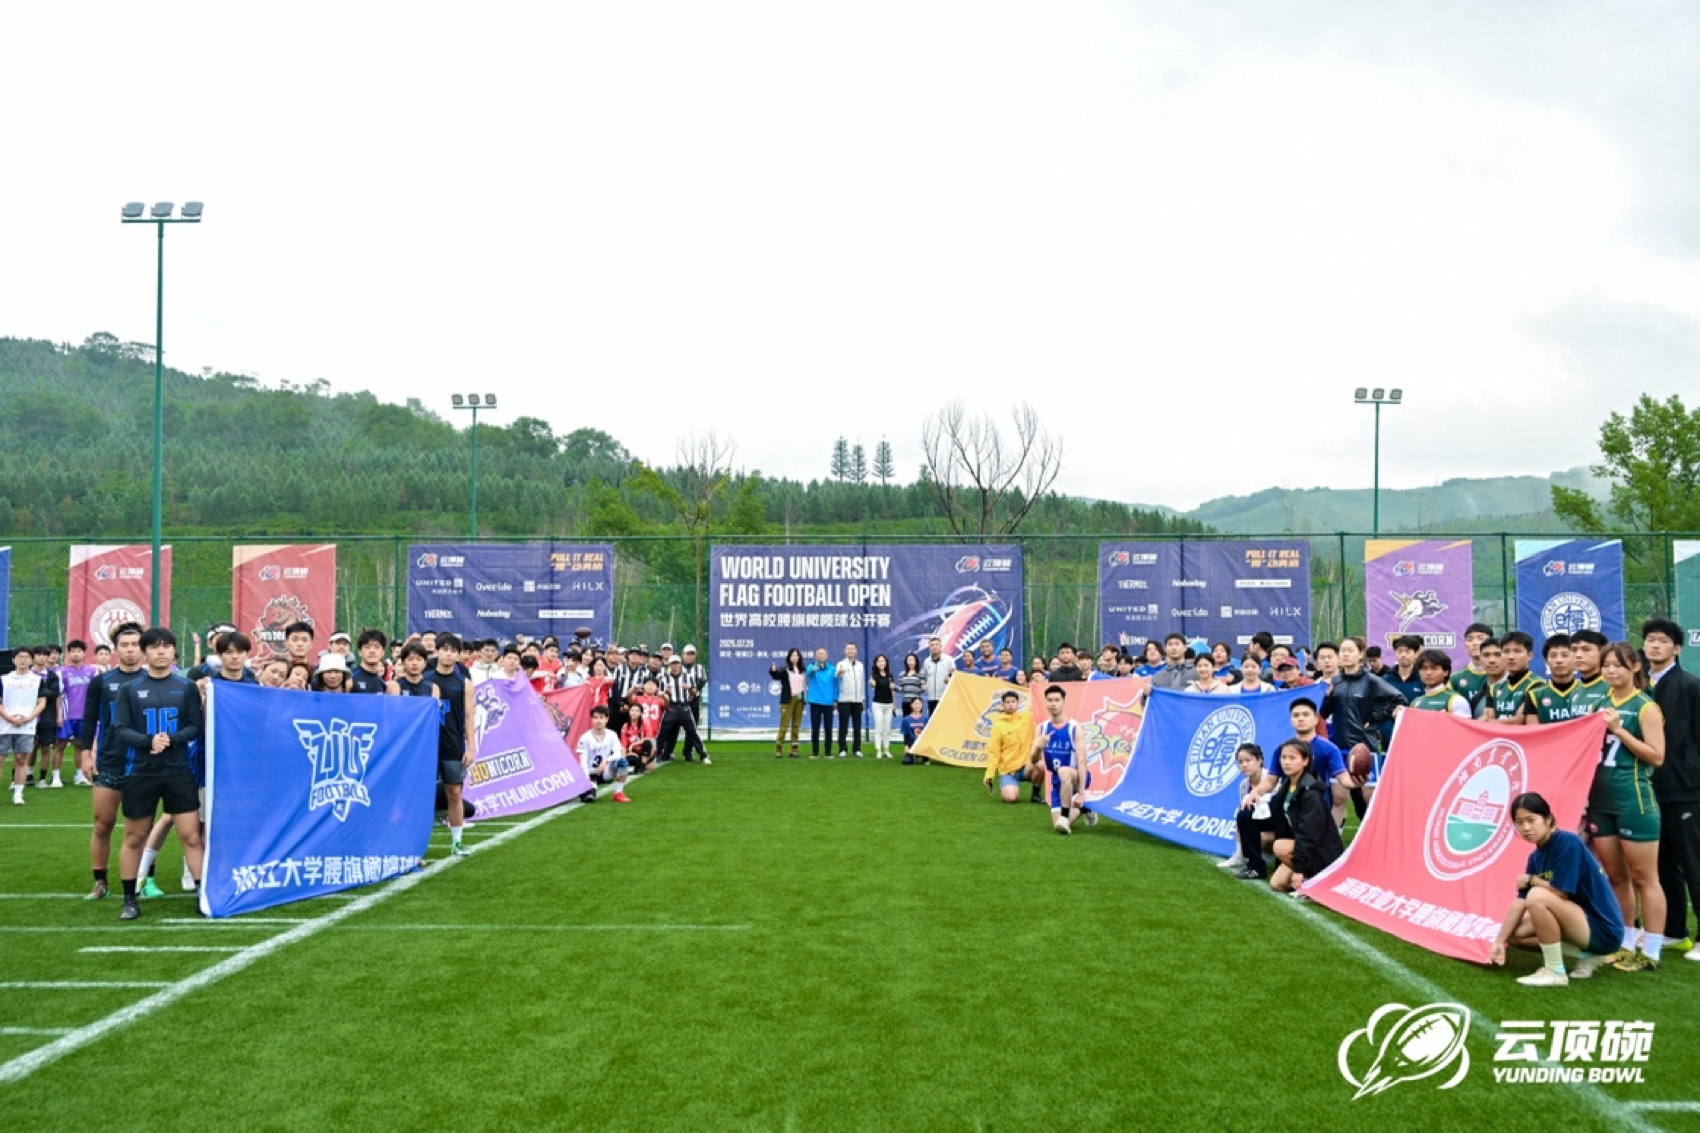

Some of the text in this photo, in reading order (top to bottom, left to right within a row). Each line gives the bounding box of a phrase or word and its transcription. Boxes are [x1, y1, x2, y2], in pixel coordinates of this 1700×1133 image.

[721, 556, 890, 579] WORLD UNIVERSITY
[720, 584, 891, 606] FLAG FOOTBALL OPEN
[143, 708, 178, 735] 16
[1599, 735, 1620, 767] 7
[232, 855, 421, 895] 浙江大学腰旗橄榄球
